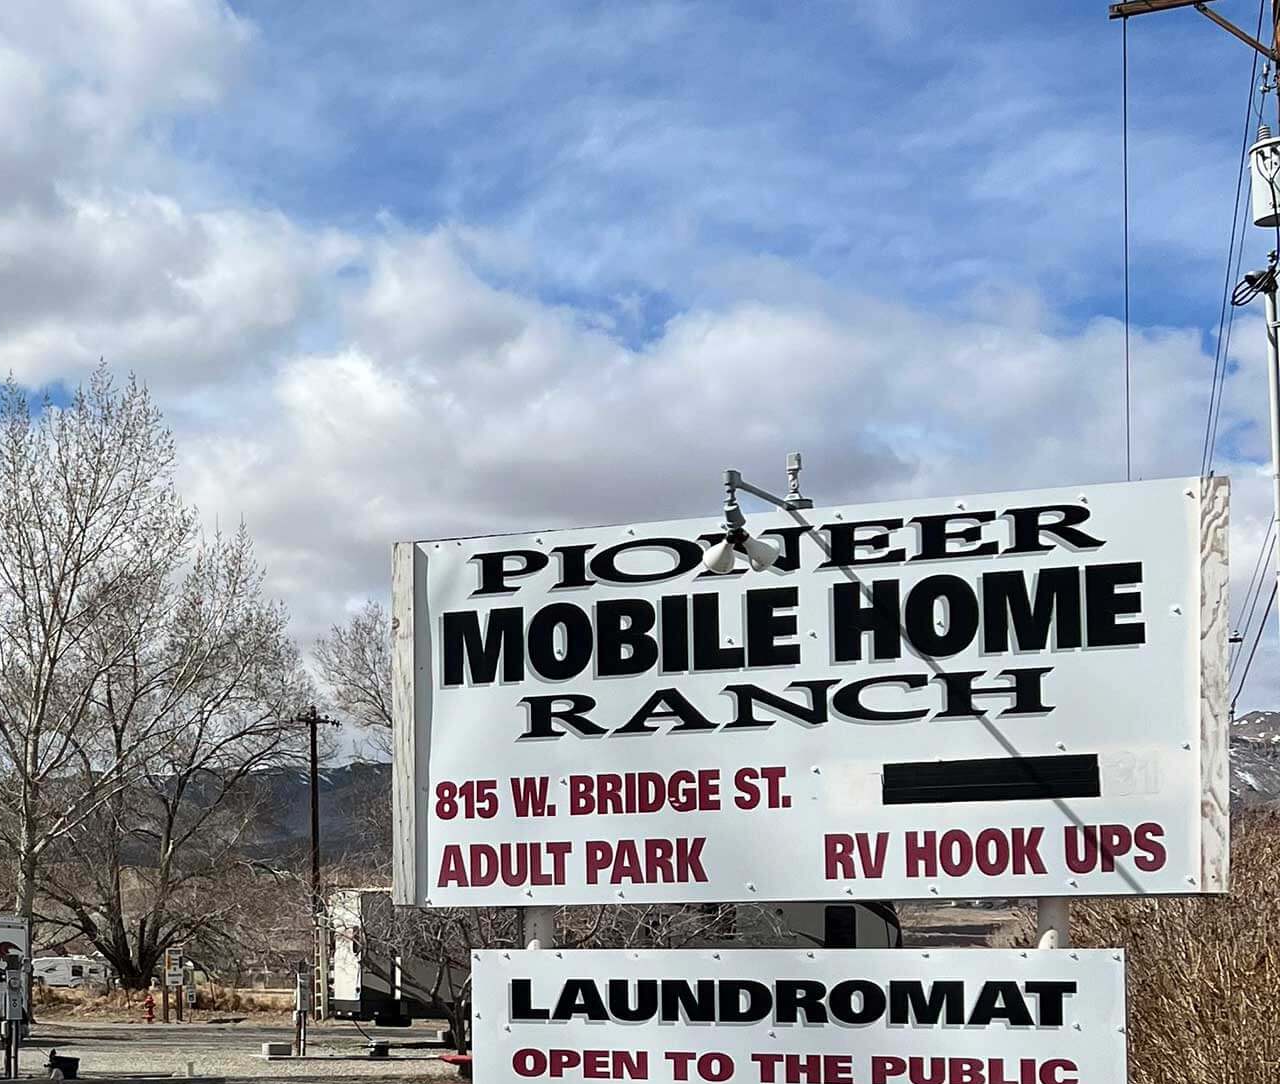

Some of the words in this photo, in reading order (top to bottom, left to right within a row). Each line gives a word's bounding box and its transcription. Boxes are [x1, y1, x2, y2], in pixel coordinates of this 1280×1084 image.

[470, 504, 1107, 594] PIONEER
[442, 586, 801, 686] MOBILE
[832, 561, 1146, 662] HOME
[516, 667, 1056, 738] RANCH
[435, 780, 498, 820] 815
[510, 777, 556, 818] W.
[570, 769, 720, 816] BRIDGE
[734, 767, 792, 810] ST.
[437, 842, 572, 888] ADULT
[585, 837, 709, 885] PARK
[824, 832, 889, 880] RV
[905, 827, 1048, 878] HOOK
[1064, 822, 1167, 874] UPS
[510, 978, 1078, 1026] LAUNDROMAT
[512, 1048, 648, 1080] OPEN
[664, 1052, 735, 1082] TO
[751, 1053, 853, 1084] THE
